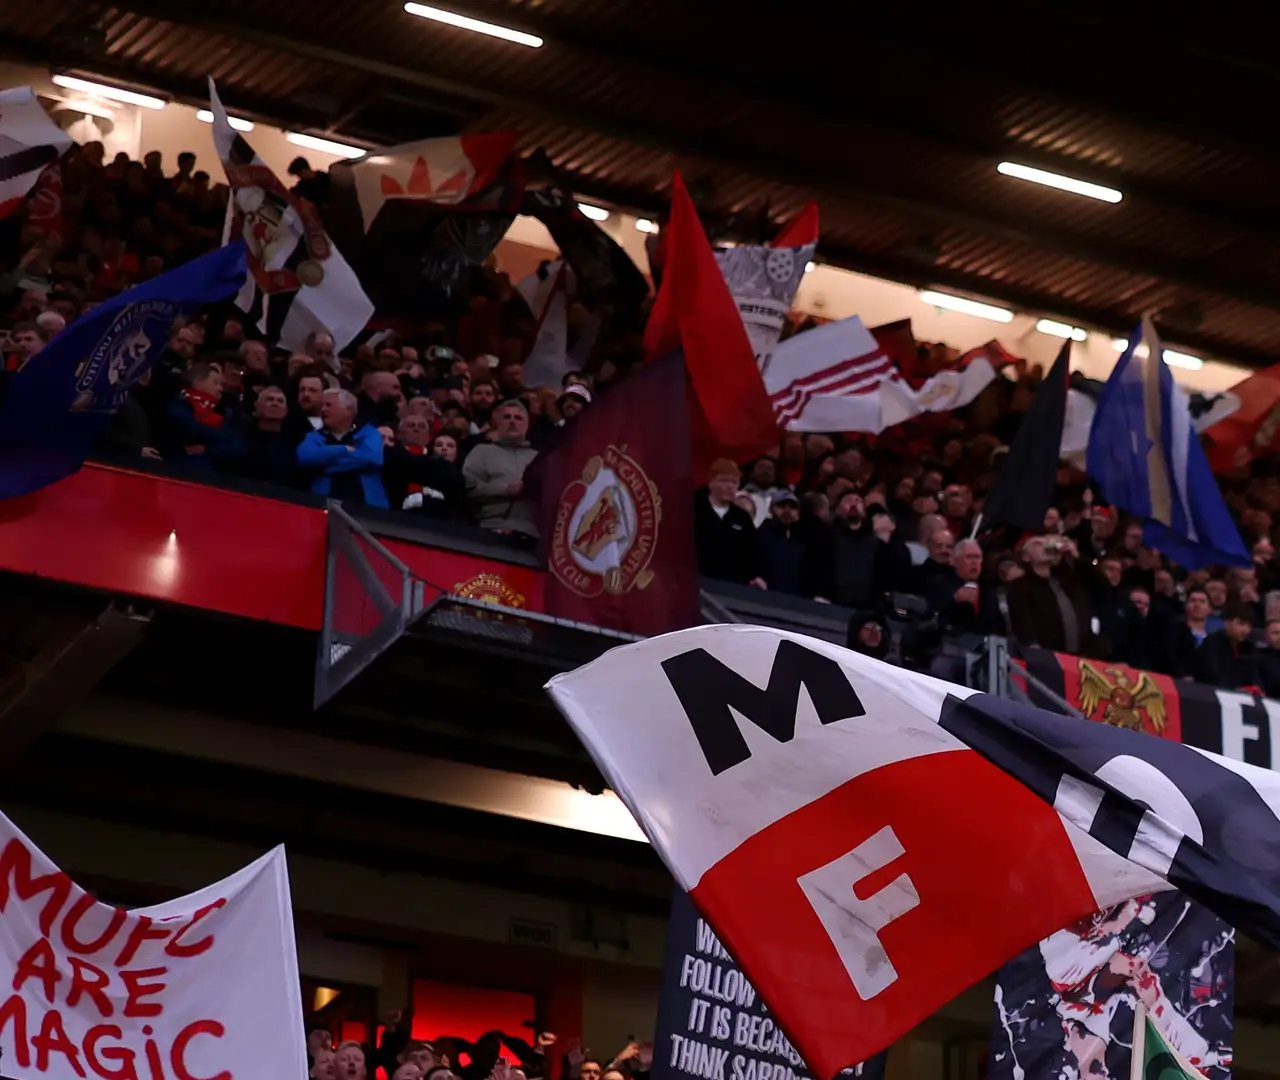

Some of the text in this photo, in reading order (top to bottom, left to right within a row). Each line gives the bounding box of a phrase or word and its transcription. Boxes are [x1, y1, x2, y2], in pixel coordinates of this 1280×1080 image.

[660, 640, 866, 776] M
[0, 838, 227, 967] MUFC
[797, 825, 921, 1001] F
[12, 937, 168, 1018] ARE
[680, 954, 756, 1008] FOLLOW
[687, 998, 711, 1034] IT
[709, 1005, 731, 1041] IS
